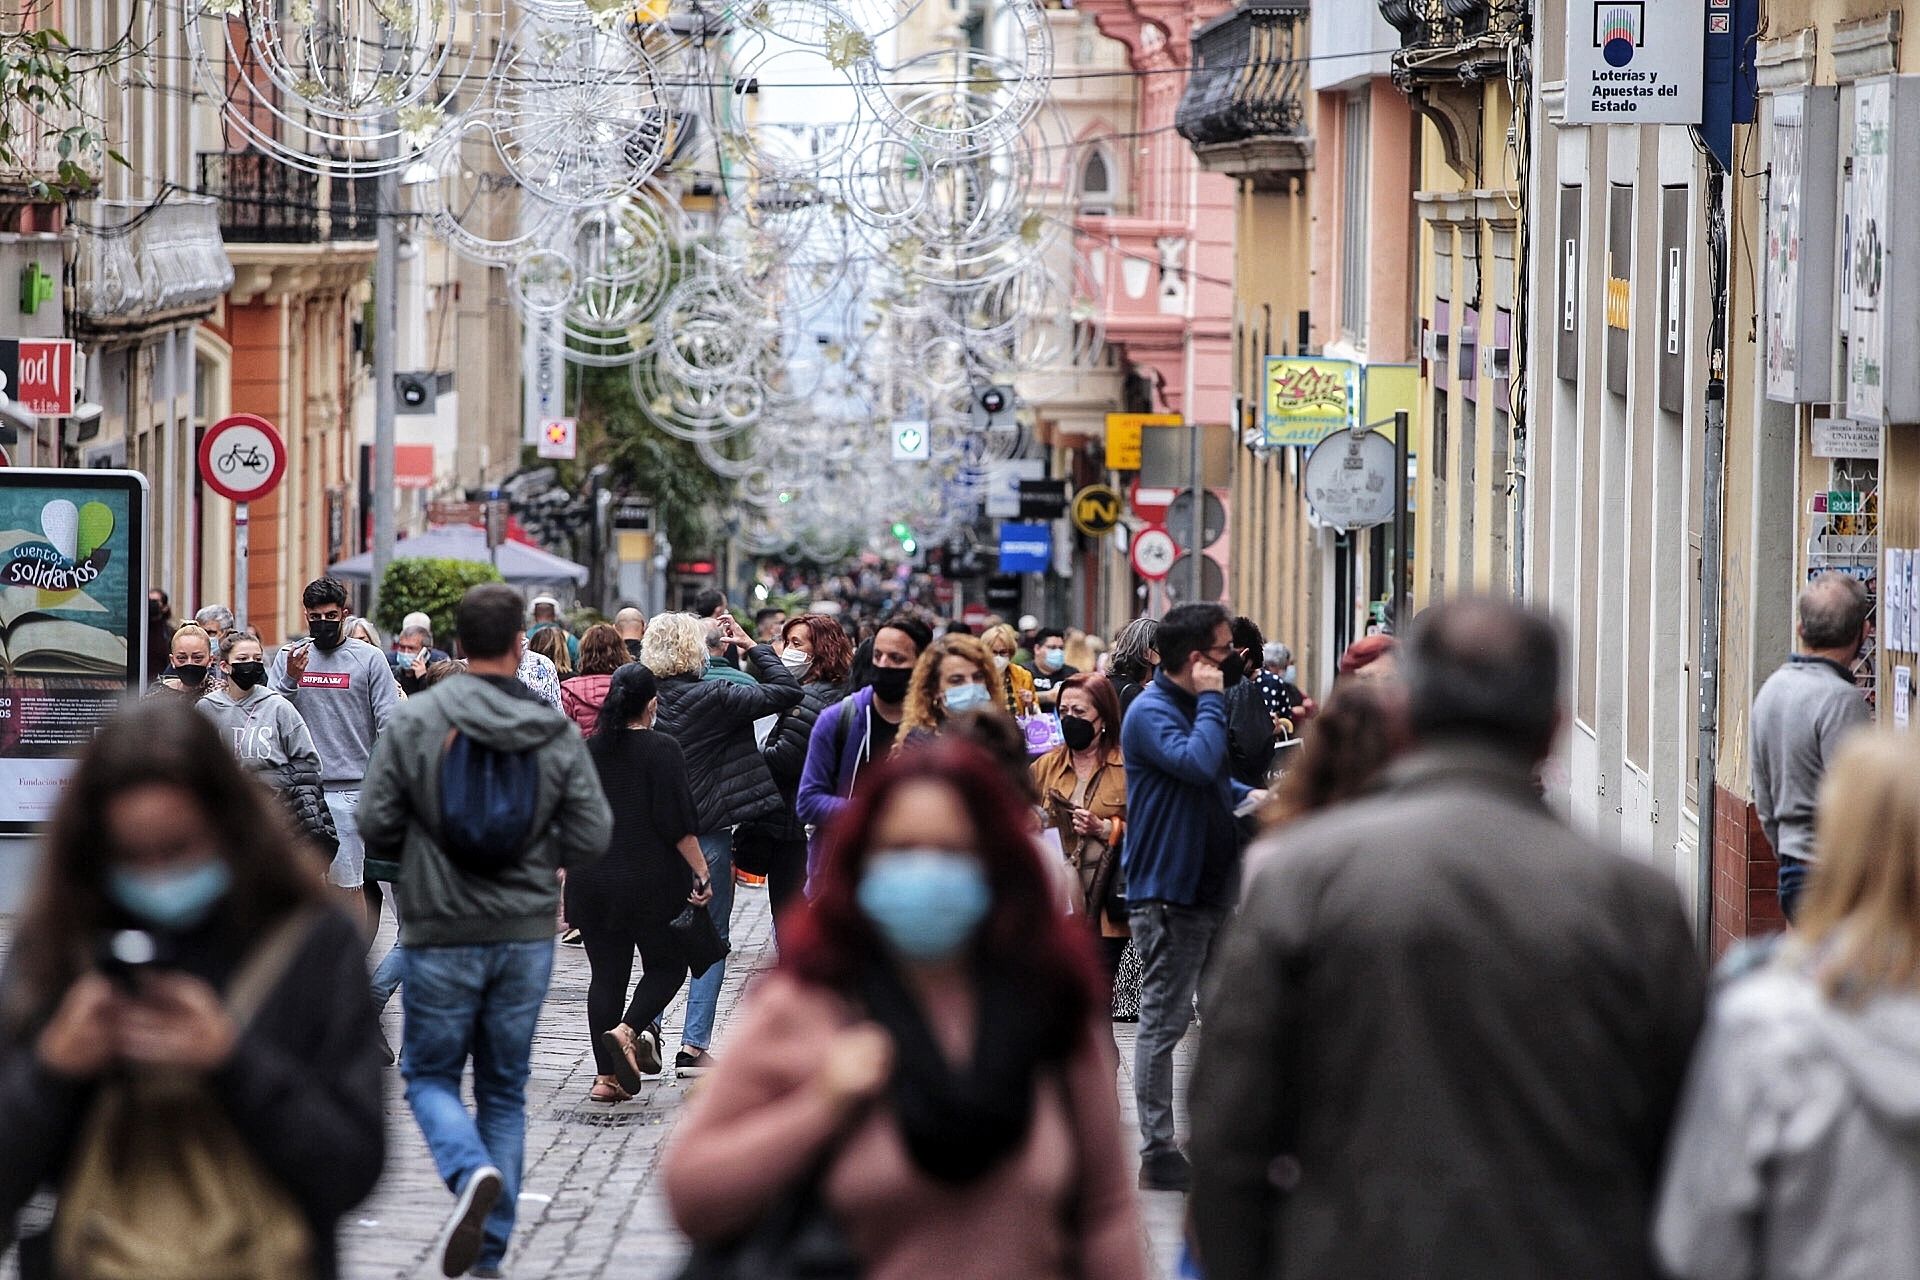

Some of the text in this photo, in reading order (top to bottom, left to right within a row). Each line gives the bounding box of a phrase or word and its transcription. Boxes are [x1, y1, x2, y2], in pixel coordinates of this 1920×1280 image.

[1592, 69, 1658, 84] Loterías y
[1592, 84, 1678, 99] Apuestas del
[1591, 100, 1637, 112] Estado
[10, 558, 98, 589] solidarios
[229, 726, 273, 760] RIS
